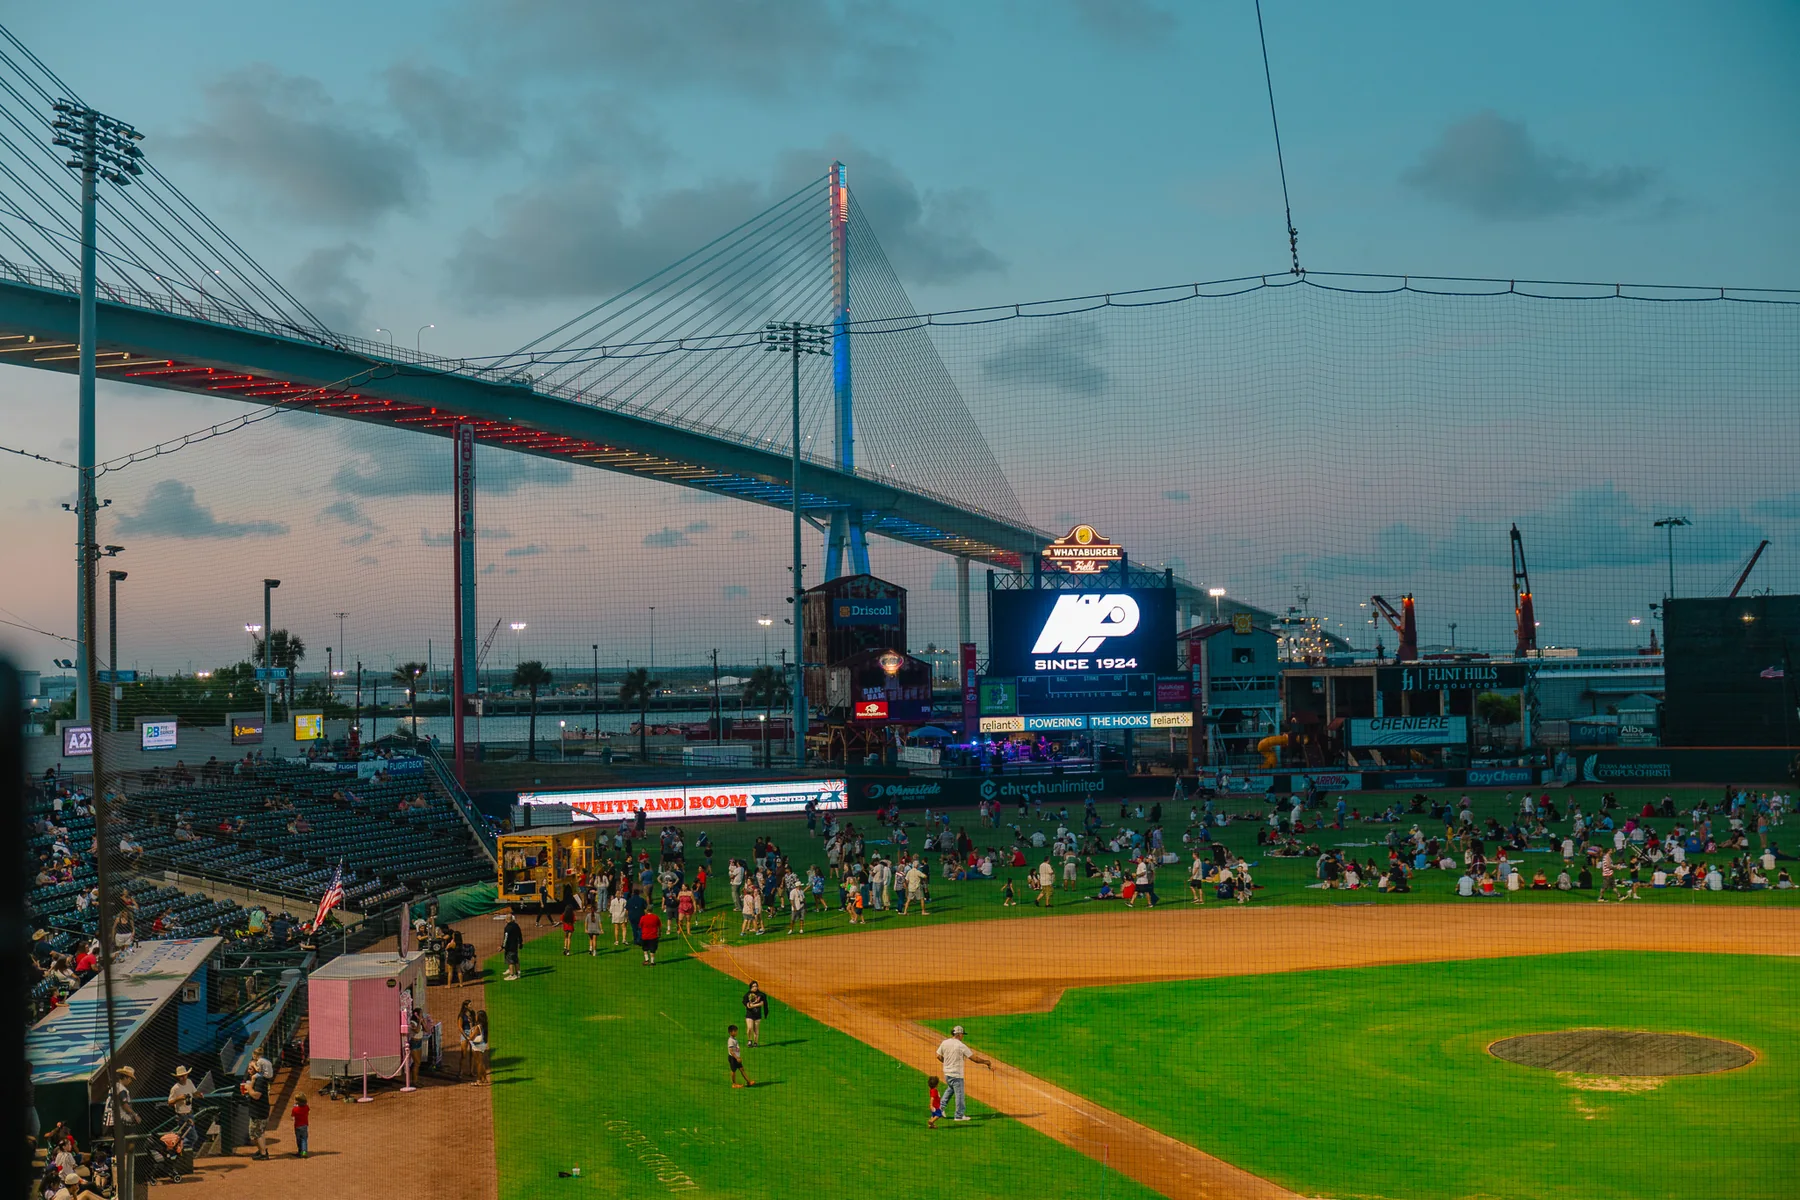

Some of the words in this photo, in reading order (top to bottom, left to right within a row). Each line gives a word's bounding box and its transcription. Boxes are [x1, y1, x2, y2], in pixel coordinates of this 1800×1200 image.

[1053, 548, 1119, 557] WHATABURGER
[1074, 560, 1095, 571] Field
[851, 605, 892, 616] Driscoll
[1034, 659, 1089, 670] SINCE
[1096, 658, 1138, 669] 1924
[273, 670, 285, 678] 110
[1428, 668, 1462, 681] FLINT
[1464, 667, 1498, 680] HILLS
[982, 719, 1013, 731] reliant
[1029, 717, 1083, 729] POWERING
[1091, 716, 1112, 727] THE
[1113, 715, 1149, 727] HOOKS
[1153, 714, 1182, 725] reliant
[1370, 717, 1449, 731] CHENIERE
[1621, 725, 1644, 733] Alba
[389, 762, 409, 770] FLIGHT
[409, 760, 423, 769] DECK
[1469, 769, 1528, 784] OxyChem
[1599, 769, 1635, 777] CORPUS
[1635, 769, 1672, 777] CHRISTI
[1315, 775, 1343, 785] ARROW
[886, 782, 941, 796] Ohmstede
[571, 798, 637, 815] WHITE
[643, 797, 685, 811] AND
[689, 794, 748, 810] BOOM
[759, 795, 806, 804] PRESENTED
